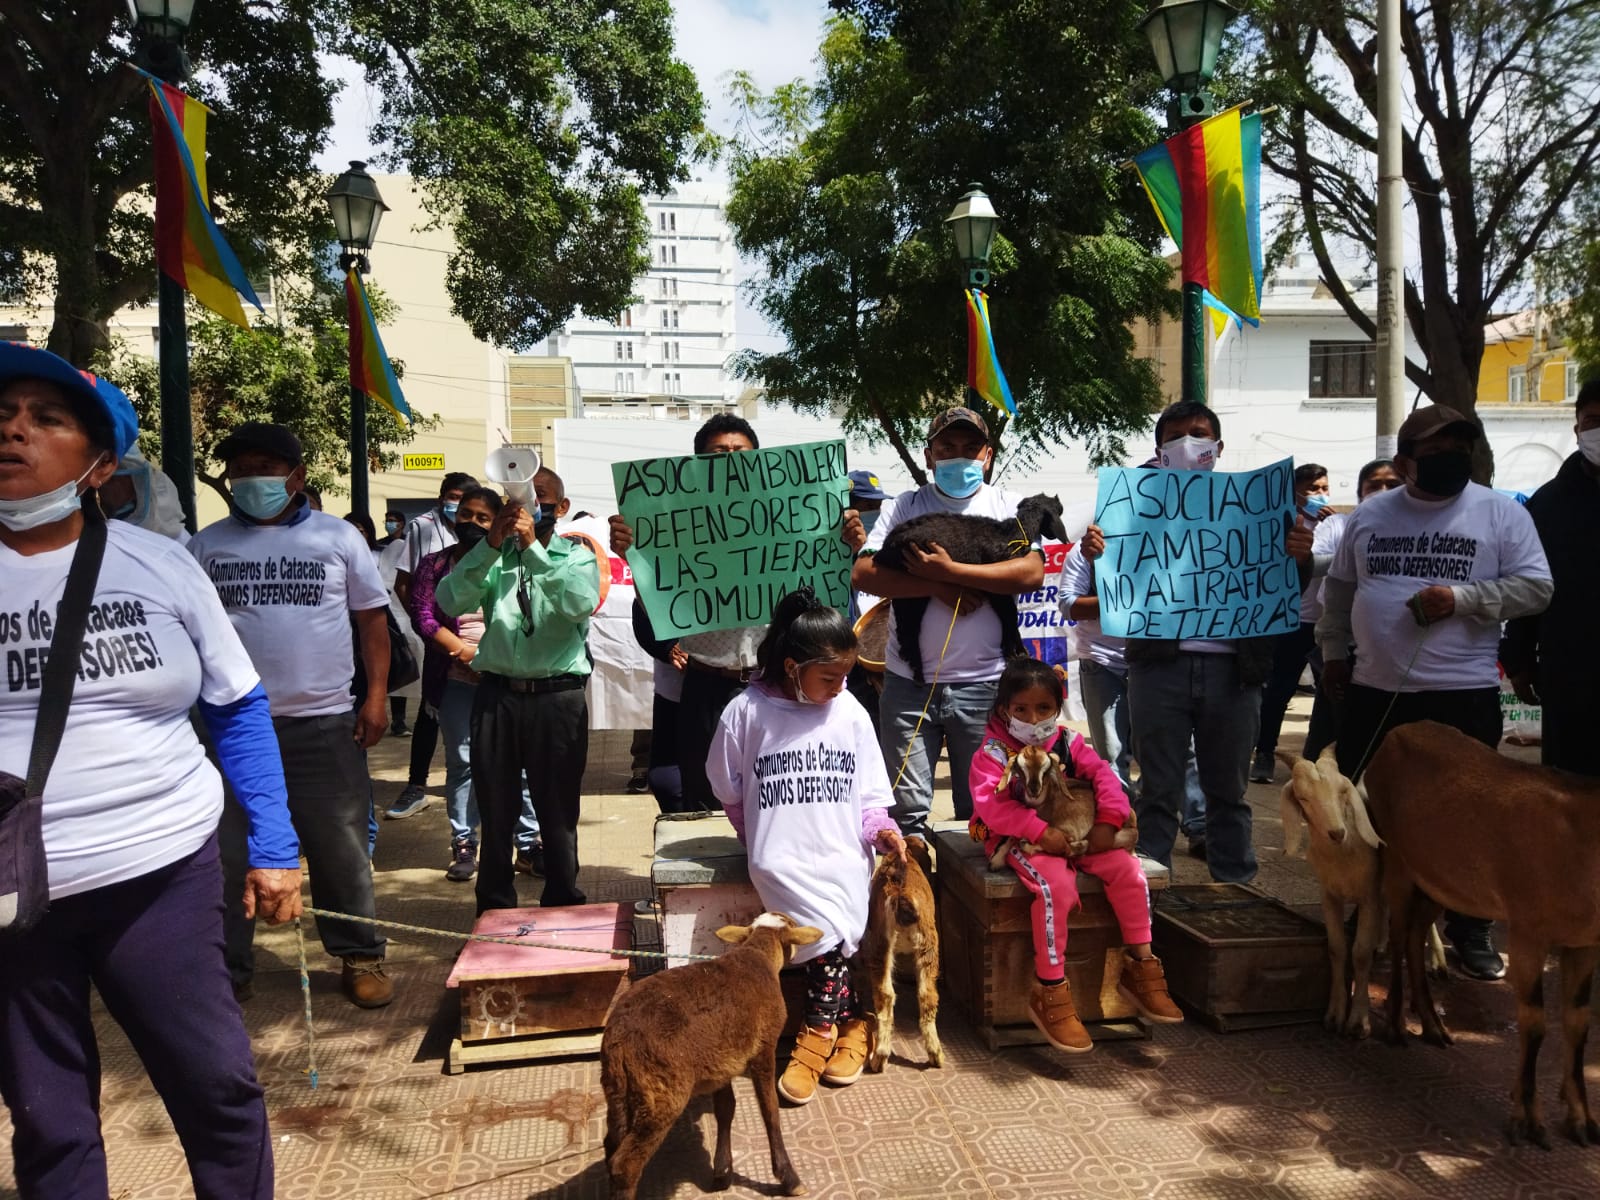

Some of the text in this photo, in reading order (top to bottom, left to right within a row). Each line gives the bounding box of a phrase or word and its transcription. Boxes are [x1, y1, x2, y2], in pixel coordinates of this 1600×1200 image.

[697, 442, 848, 497] TAMBOLERO
[1096, 463, 1296, 522] ASOCIACION
[635, 493, 821, 550] DEFENSORES
[655, 536, 852, 591] LAS TIERRAS
[1367, 531, 1476, 557] Comuneros de Catacaos
[209, 556, 326, 582] Comuneros de Catacaos
[1103, 557, 1296, 613] NO AL TRAFICO
[1402, 556, 1473, 581] DEFENSORES!
[216, 583, 324, 607] OMOS DEFENSORES!
[1127, 592, 1299, 640] DE TIERRAS
[28, 600, 52, 640] de
[753, 750, 803, 780] Comuneros
[805, 742, 817, 771] de
